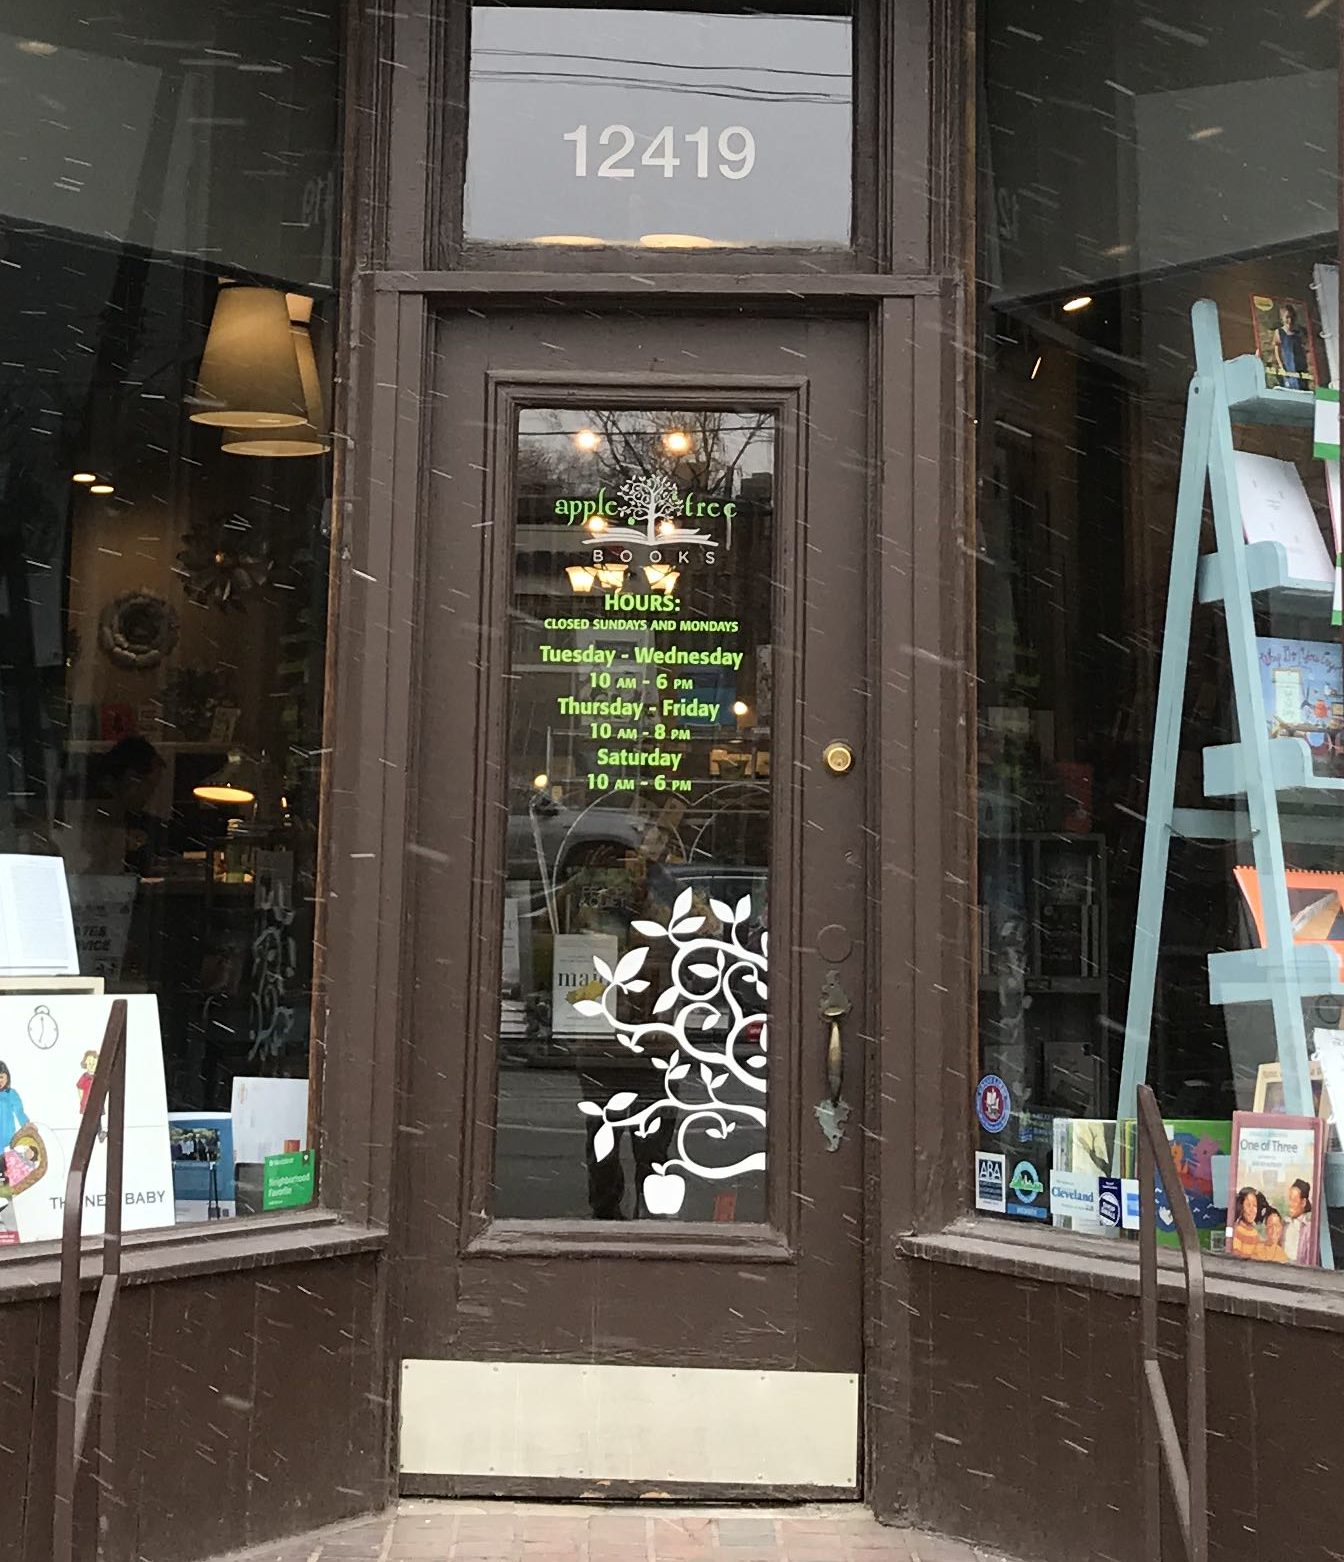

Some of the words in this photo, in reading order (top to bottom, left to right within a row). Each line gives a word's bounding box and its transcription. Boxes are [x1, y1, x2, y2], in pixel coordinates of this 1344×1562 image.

[562, 124, 757, 180] 12419
[555, 487, 619, 527] apple
[686, 489, 738, 519] tree
[593, 549, 716, 565] BOOKS
[604, 593, 681, 612] HOURS:
[544, 618, 590, 631] CLOSED
[593, 618, 648, 631] SUNDAYS
[650, 619, 677, 632] AND
[680, 620, 739, 633] MONDAYS
[540, 645, 616, 669] Tuesday
[635, 647, 744, 671] Wednesday
[589, 672, 611, 689] 10
[616, 676, 637, 689] AM
[656, 673, 668, 690] 6
[674, 678, 694, 690] PM
[557, 697, 644, 721] Thursday
[663, 698, 721, 722] Friday
[590, 722, 612, 739] 10
[617, 727, 638, 740] AM
[654, 723, 667, 740] 8
[671, 728, 691, 740] PM
[597, 748, 682, 771] Saturday
[587, 774, 609, 790] 10
[614, 778, 635, 791] AM
[654, 775, 667, 792] 6
[671, 779, 693, 792] PM
[1240, 1139, 1259, 1151] One
[1260, 1140, 1270, 1151] of
[1272, 1140, 1298, 1154] Three
[979, 1160, 1002, 1180] ABA
[125, 1190, 166, 1205] BABY
[1051, 1186, 1094, 1203] Cleveland
